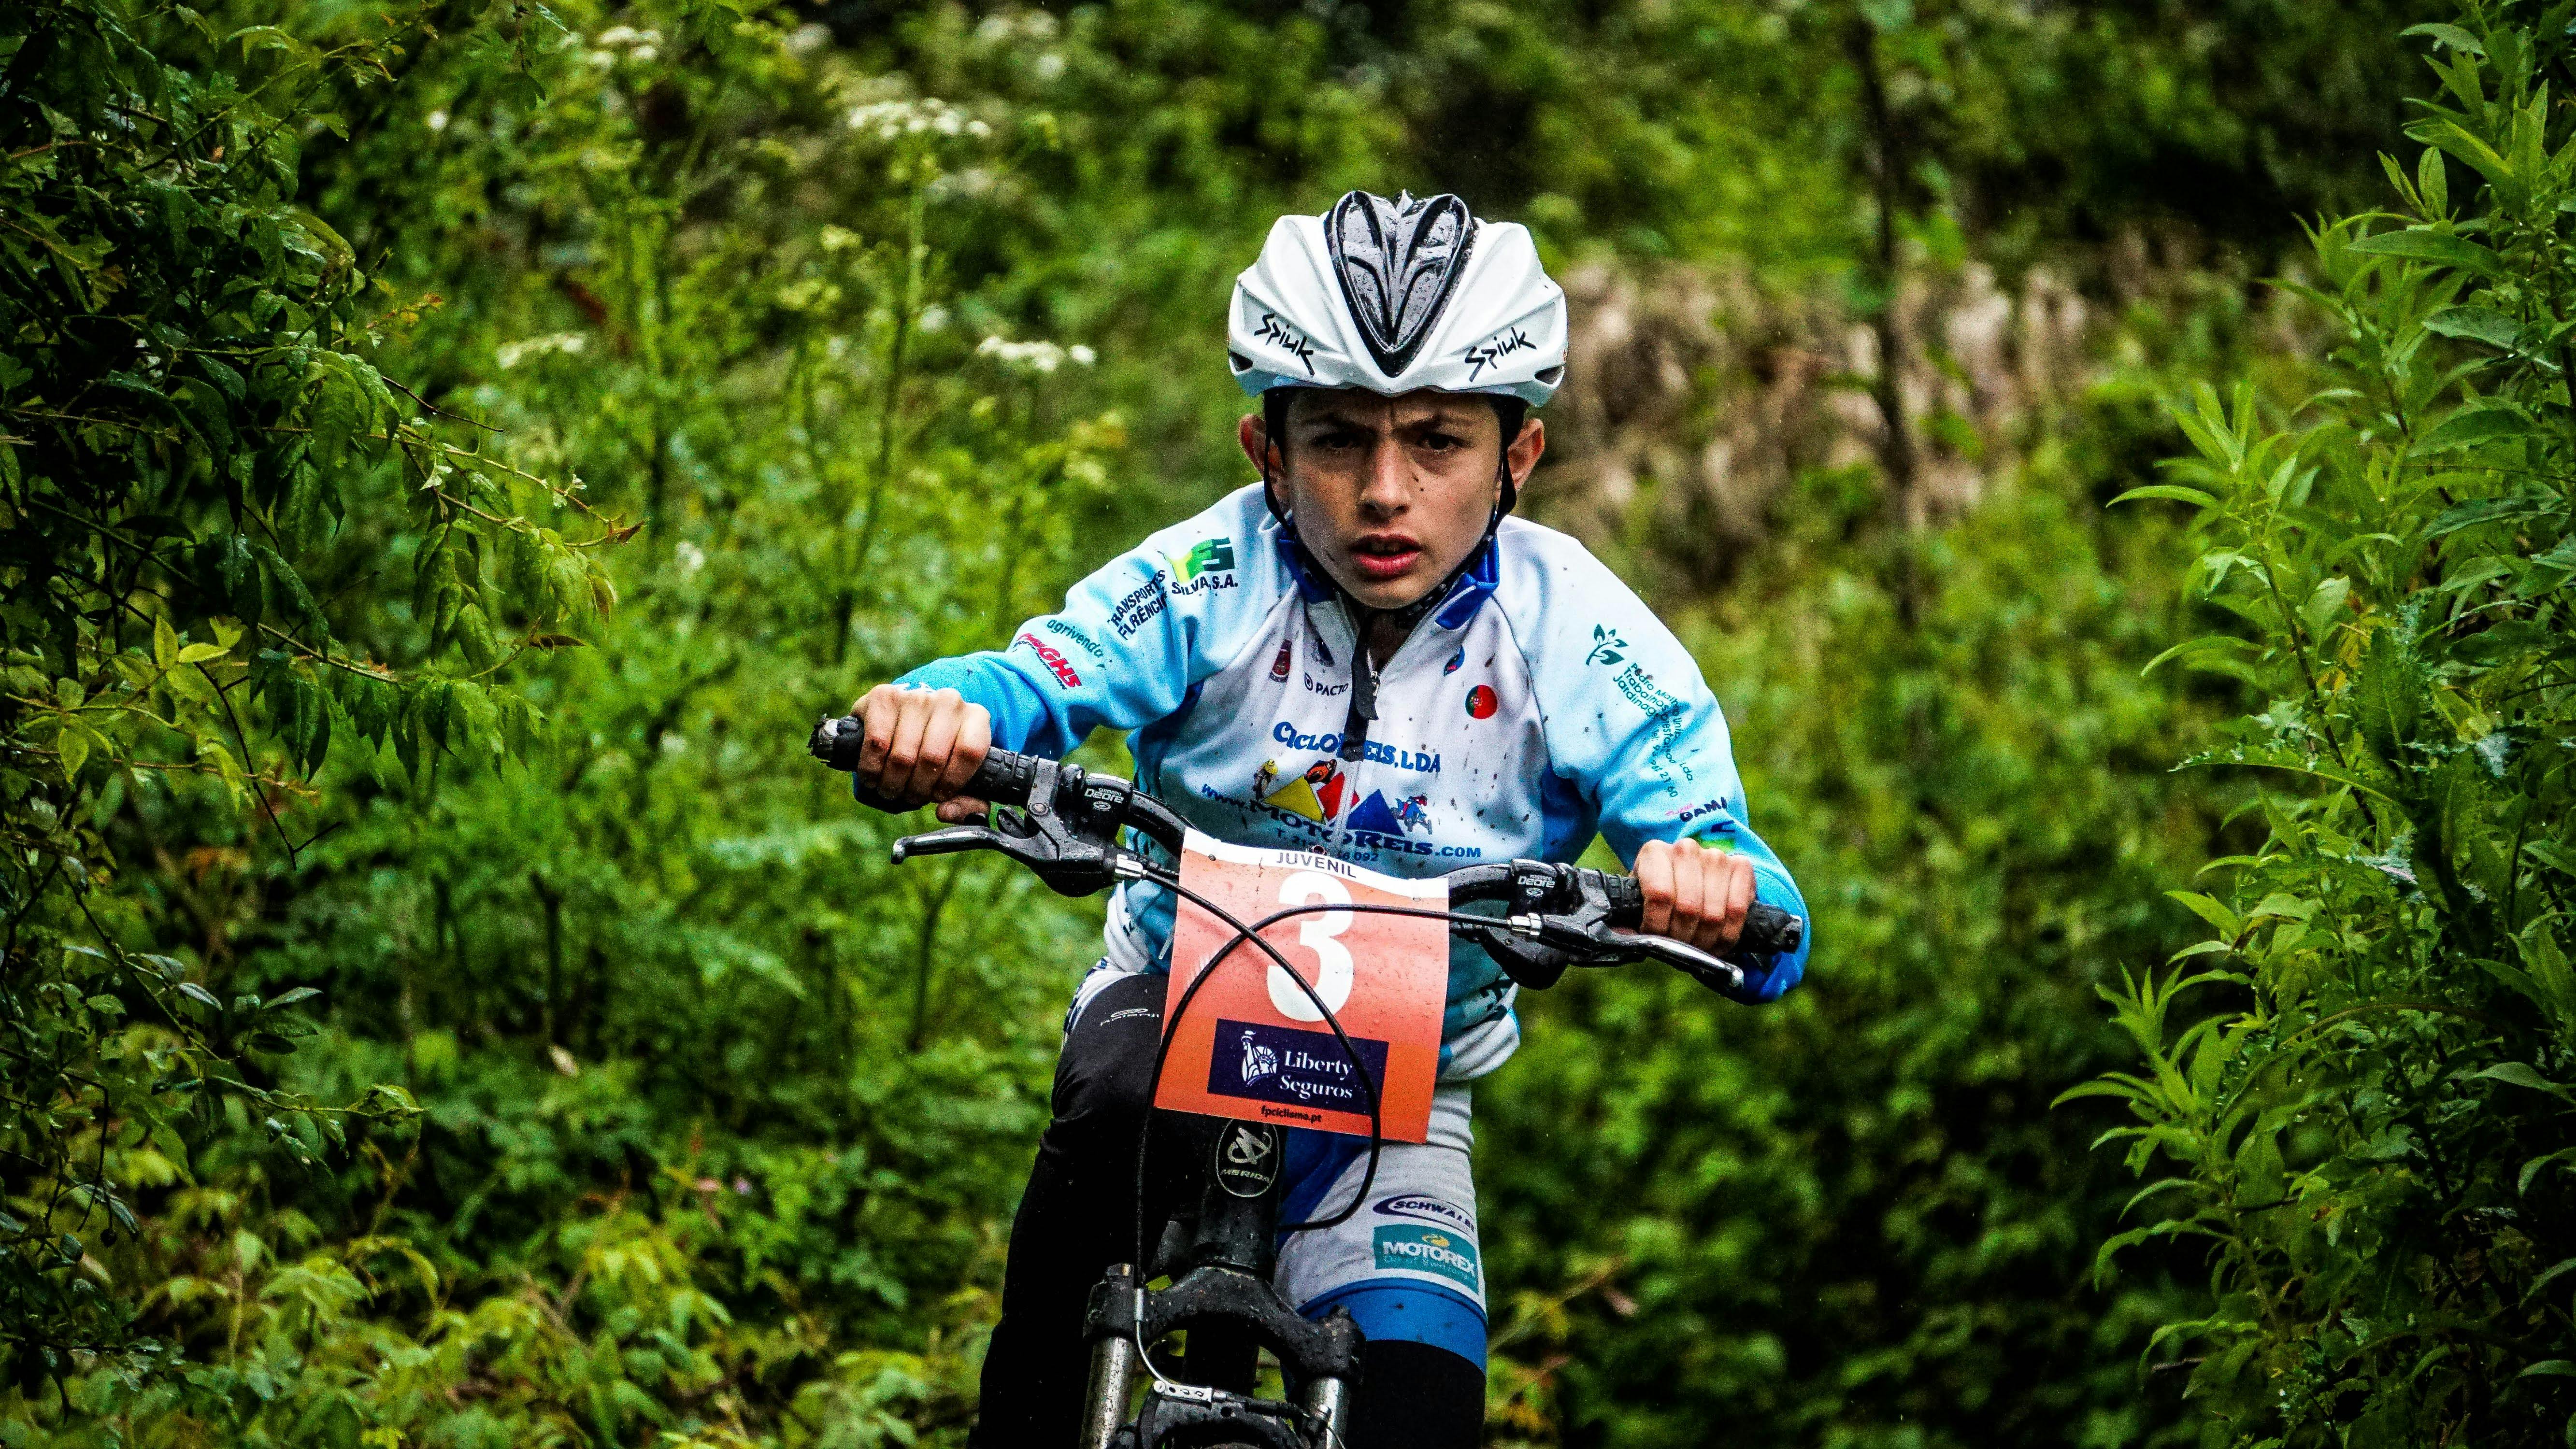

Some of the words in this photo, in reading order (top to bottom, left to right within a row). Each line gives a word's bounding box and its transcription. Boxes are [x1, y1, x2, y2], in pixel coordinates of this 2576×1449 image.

[1254, 313, 1315, 376] Spiuk
[1464, 327, 1537, 382] Spiuk
[1046, 619, 1103, 658] agrivendo
[1084, 788, 1124, 804] Deore
[1276, 852, 1357, 879] JUVENIL
[1518, 876, 1556, 888] Deore
[1267, 872, 1355, 1022] 3
[1285, 1051, 1353, 1081] Liberty
[1280, 1074, 1353, 1099] Seguros
